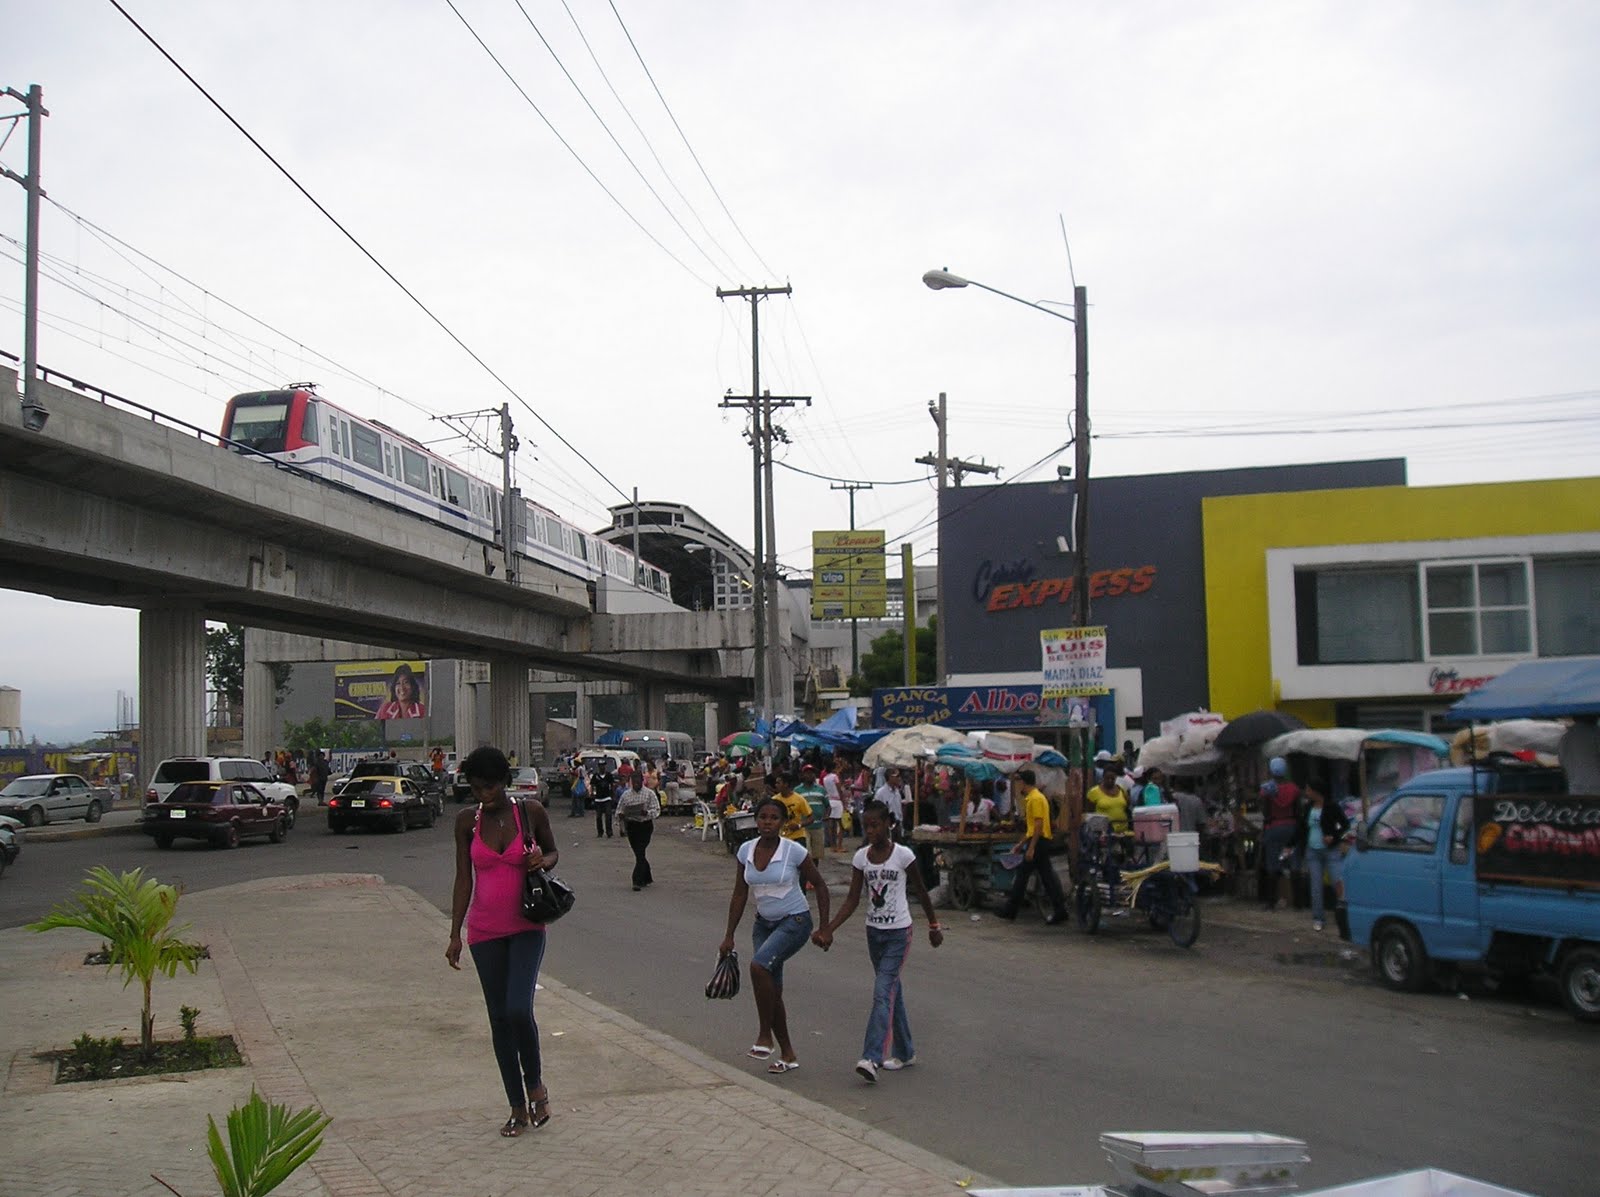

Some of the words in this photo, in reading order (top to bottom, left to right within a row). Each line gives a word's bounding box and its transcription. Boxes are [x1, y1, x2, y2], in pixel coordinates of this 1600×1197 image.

[1045, 640, 1104, 654] LUIS
[1079, 666, 1104, 679] DIAZ
[1044, 687, 1106, 696] MUSICAL
[882, 690, 948, 708] BANCA
[905, 705, 925, 714] DE
